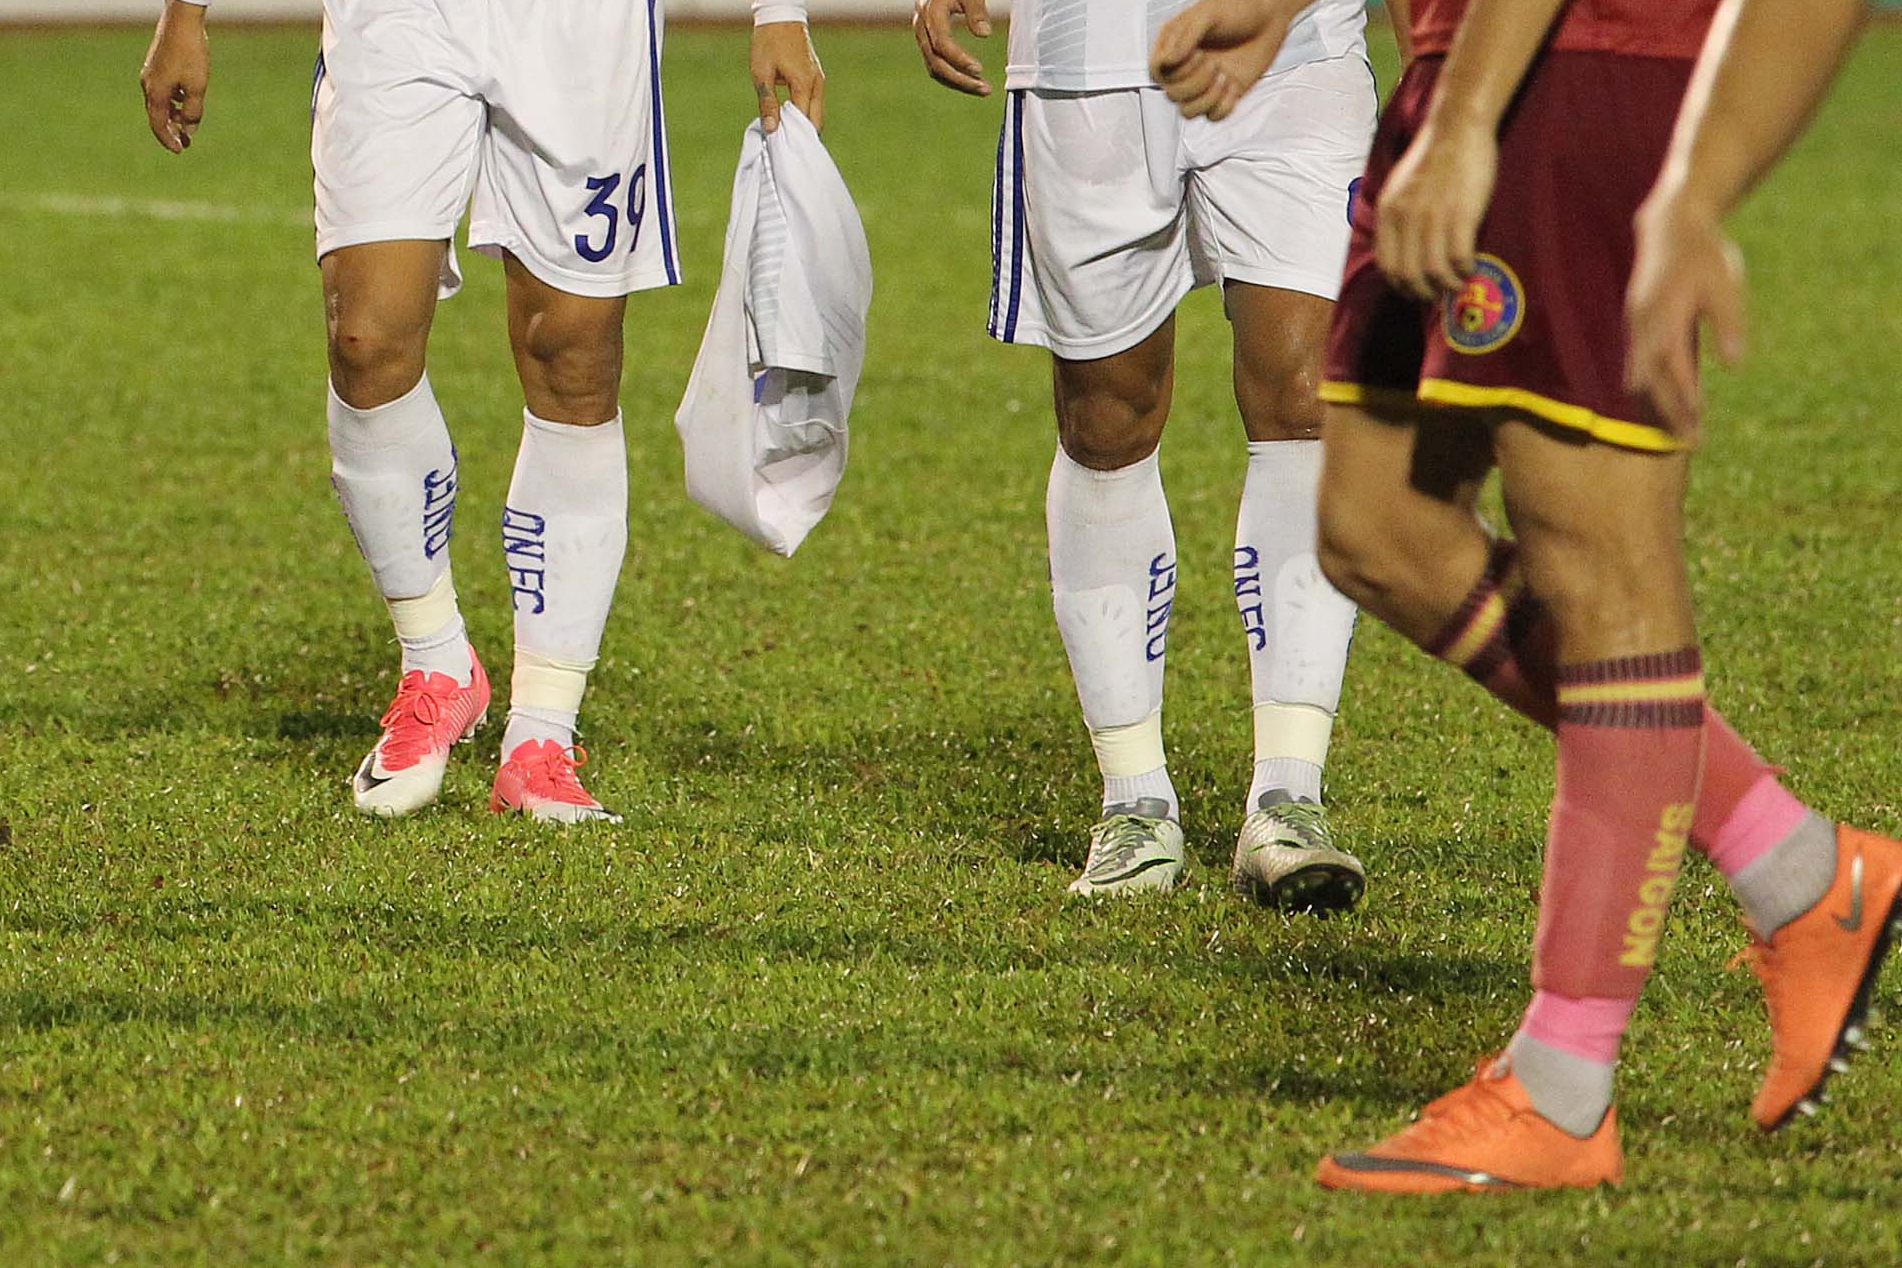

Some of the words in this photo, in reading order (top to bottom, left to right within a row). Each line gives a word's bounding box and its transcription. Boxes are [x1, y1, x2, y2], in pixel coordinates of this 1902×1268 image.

[574, 163, 646, 263] 39
[502, 507, 545, 614] QNFC
[1618, 802, 1695, 967] SAIGON
